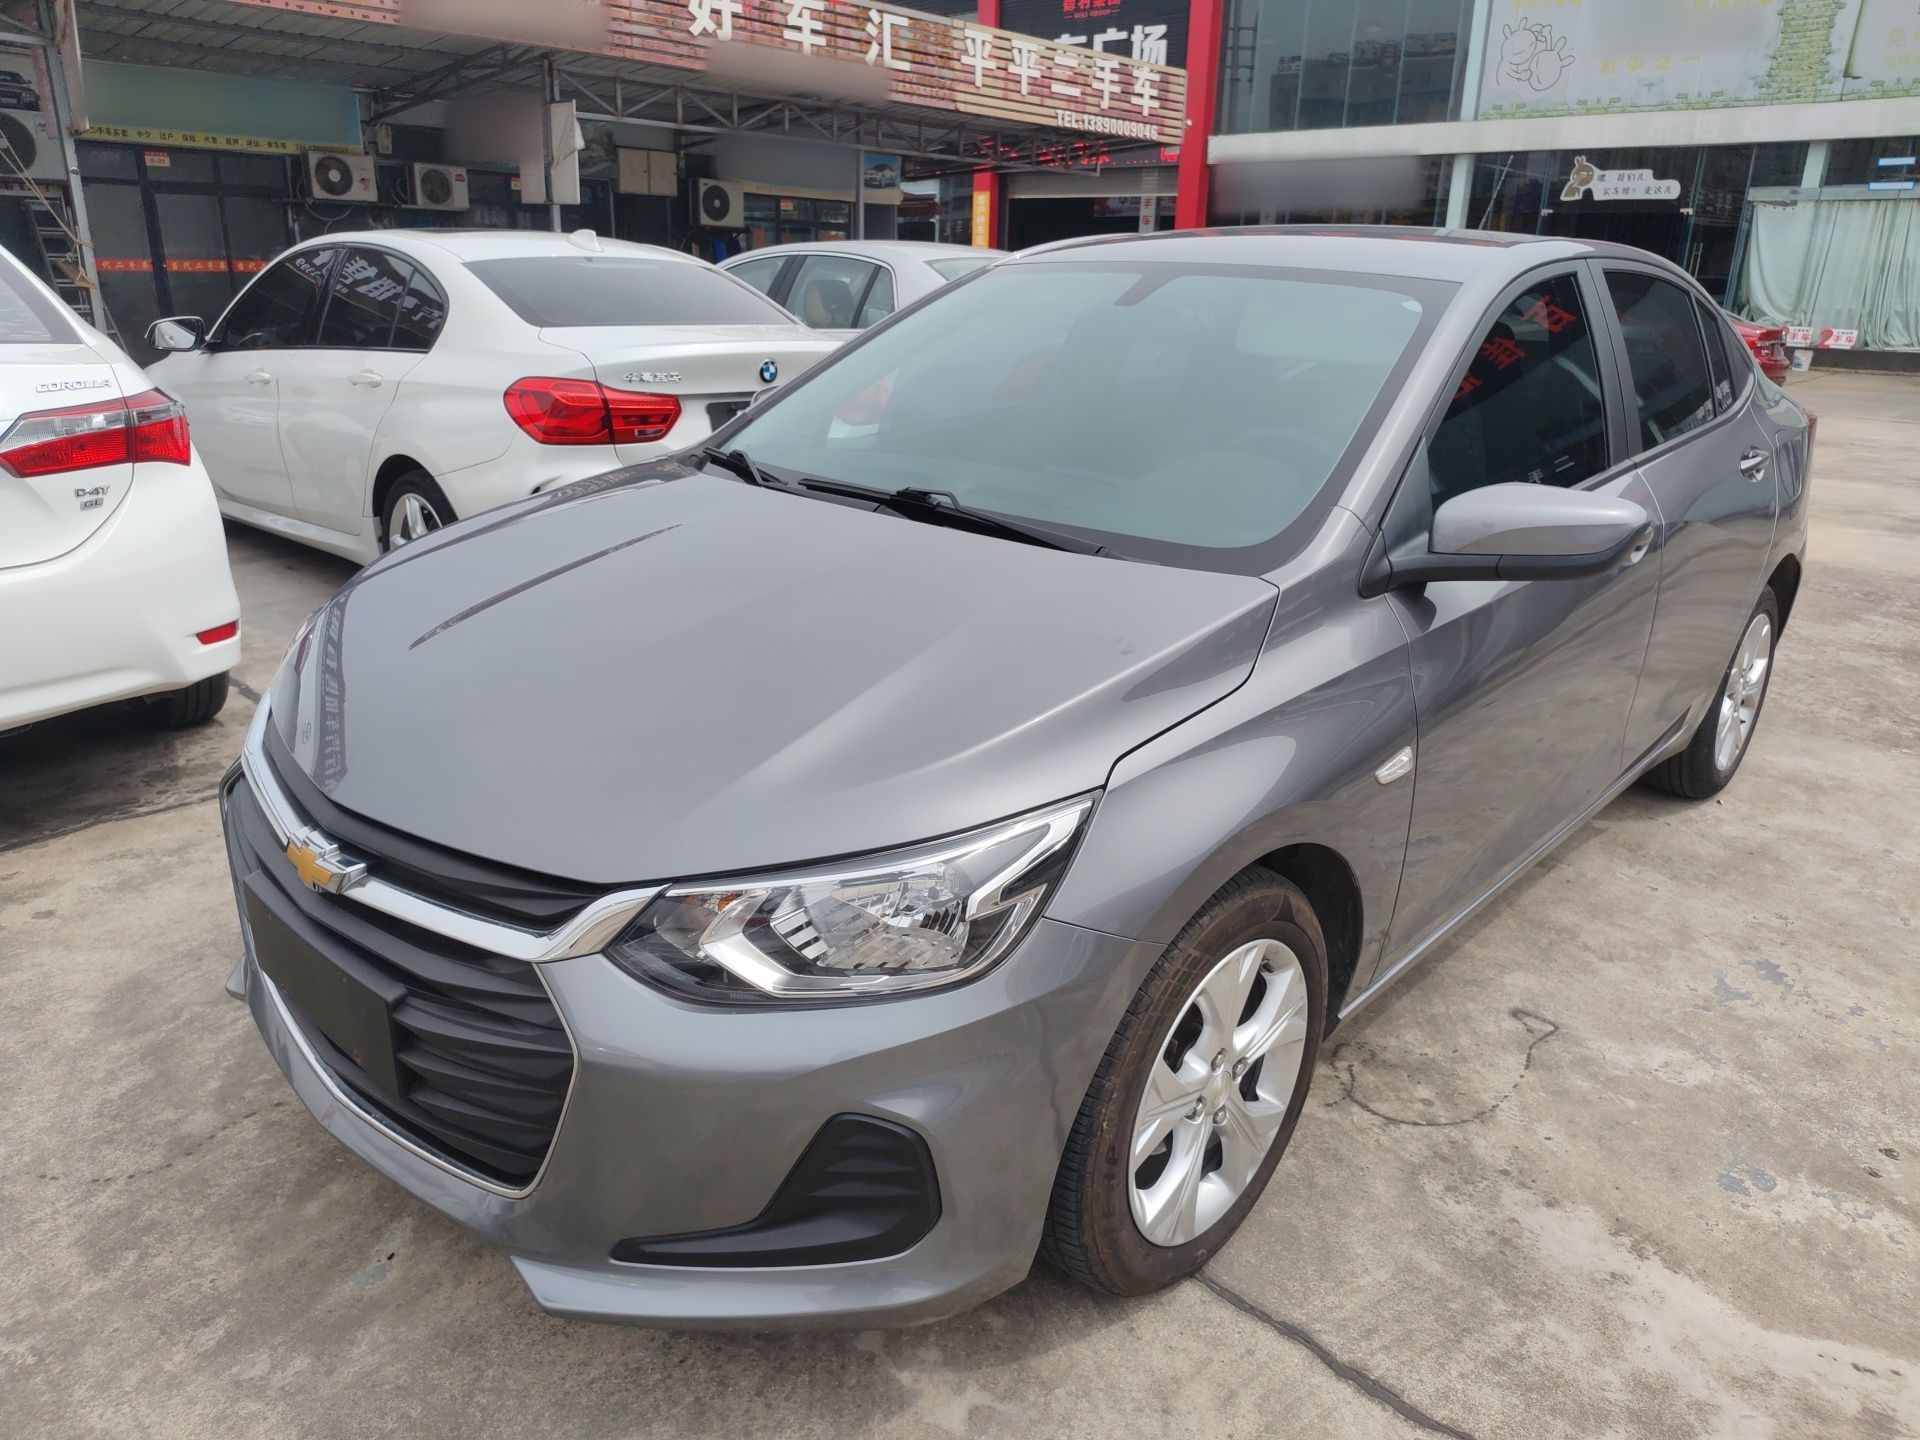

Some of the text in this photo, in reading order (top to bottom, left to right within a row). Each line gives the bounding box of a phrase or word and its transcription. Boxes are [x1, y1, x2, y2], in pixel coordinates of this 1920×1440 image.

[1054, 24, 1168, 66] 广场
[960, 27, 1161, 116] 平平二手车
[36, 380, 112, 393] COROLLA
